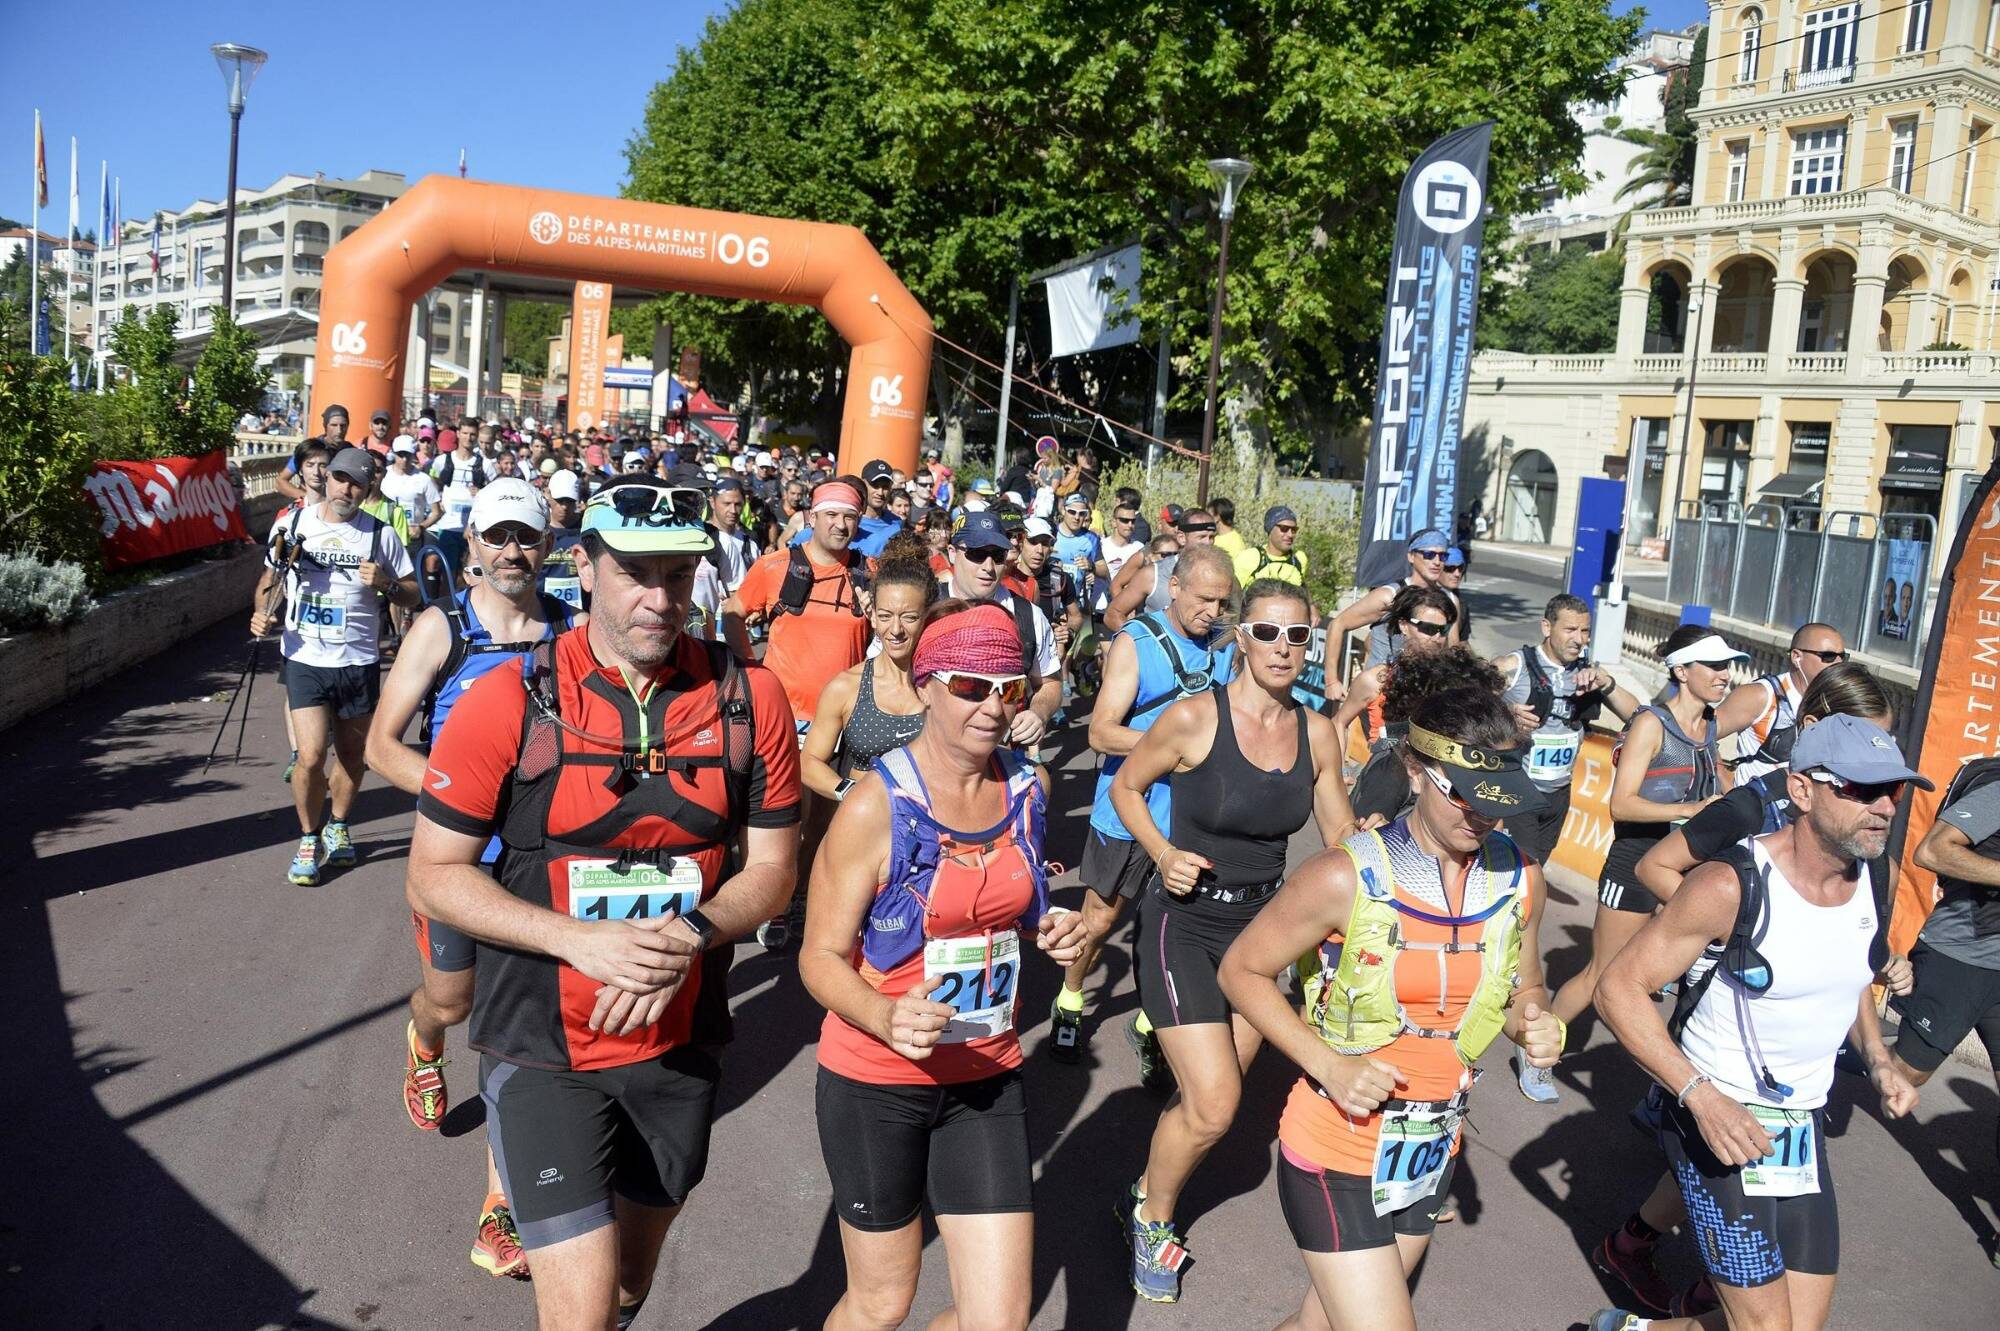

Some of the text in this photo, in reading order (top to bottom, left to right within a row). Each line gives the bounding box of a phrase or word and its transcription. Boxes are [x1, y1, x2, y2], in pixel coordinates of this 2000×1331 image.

[568, 215, 707, 243] DÉPARTEMENT
[567, 232, 705, 259] DES ALPES-MARITIMES
[718, 233, 770, 268] 06
[581, 284, 604, 299] 06
[331, 321, 367, 354] 06
[870, 374, 903, 406] 06
[1373, 245, 1418, 542] SPORT
[1391, 246, 1435, 541] CONSULTING
[82, 463, 236, 539] Malongo
[554, 588, 573, 601] 26
[307, 605, 334, 625] 56
[1959, 551, 2000, 766] ARTEMENT
[1536, 747, 1573, 767] 149
[640, 871, 661, 883] 06
[936, 962, 1013, 1013] 212
[1384, 1134, 1451, 1181] 105
